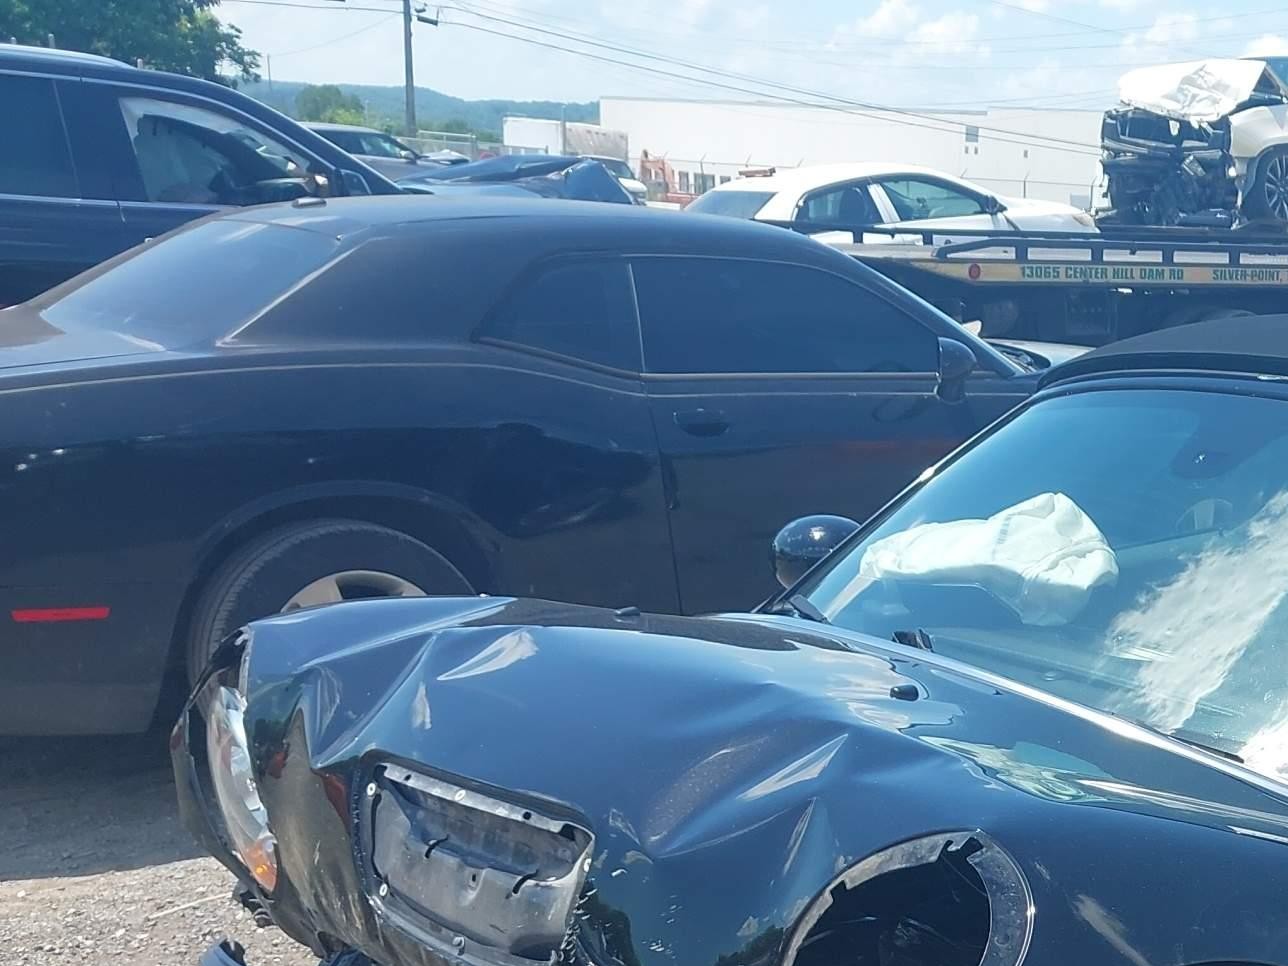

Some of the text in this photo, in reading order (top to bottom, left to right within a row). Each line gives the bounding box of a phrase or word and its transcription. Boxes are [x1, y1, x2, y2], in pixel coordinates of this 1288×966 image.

[1020, 266, 1184, 280] 13065 CENTER HILL DAM RD
